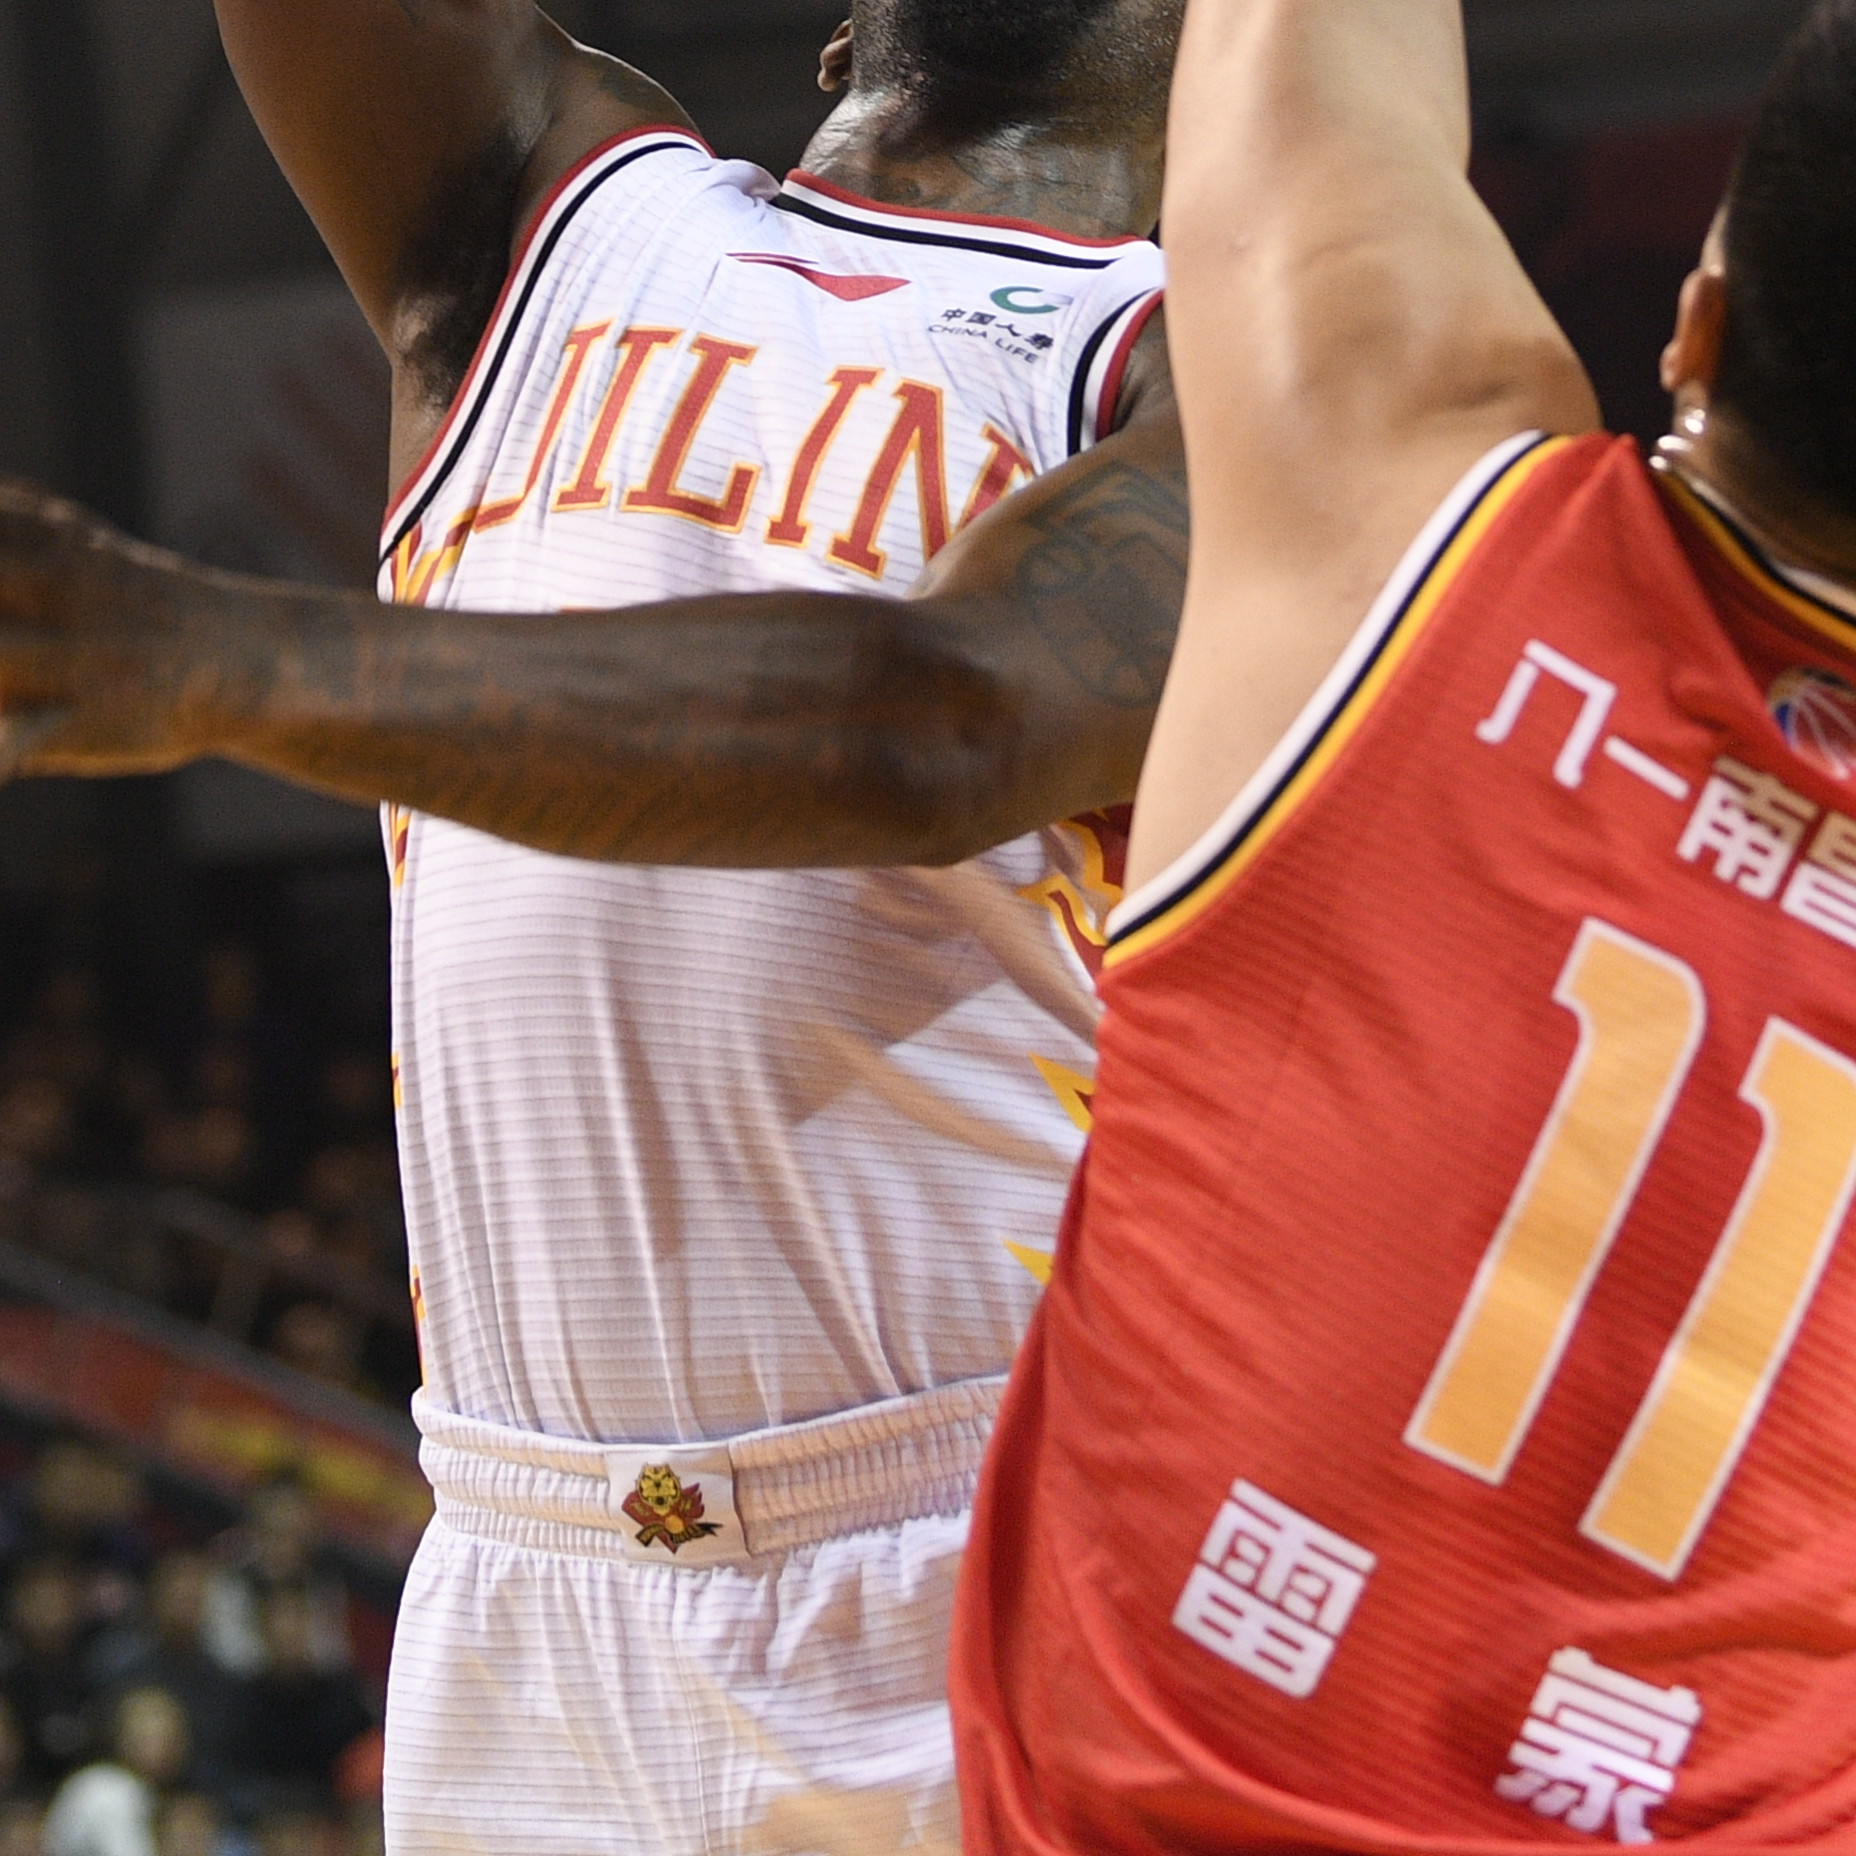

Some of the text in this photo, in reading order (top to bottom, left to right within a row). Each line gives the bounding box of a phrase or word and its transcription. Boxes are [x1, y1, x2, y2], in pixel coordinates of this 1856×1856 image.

[928, 324, 1040, 365] CHINA LIFE
[446, 316, 1036, 582] JILIN
